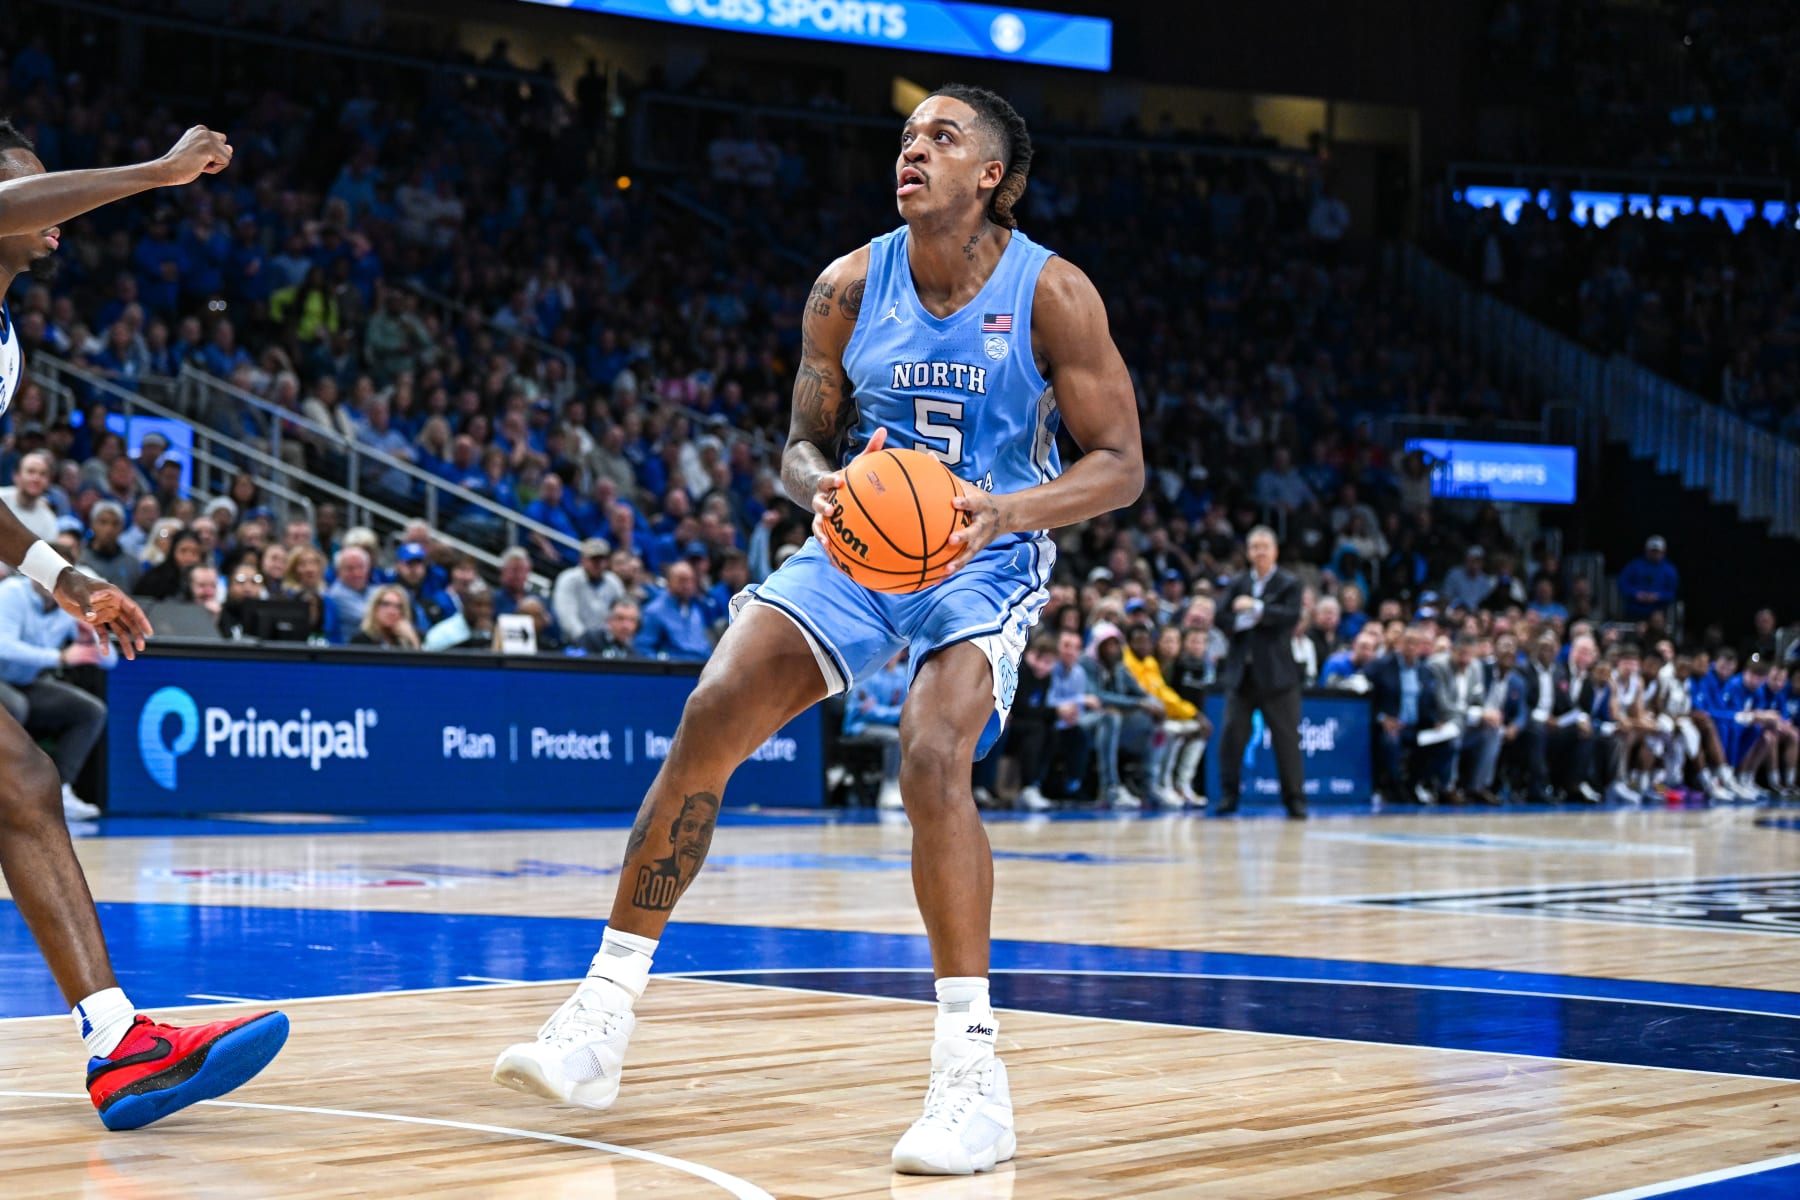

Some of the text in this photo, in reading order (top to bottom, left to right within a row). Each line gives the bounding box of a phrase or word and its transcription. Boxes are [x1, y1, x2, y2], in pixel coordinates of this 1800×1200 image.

[767, 0, 907, 39] SPORTS
[892, 362, 986, 395] NORTH
[913, 396, 965, 467] 5
[442, 725, 496, 759] Plan
[531, 726, 613, 760] Protect
[965, 1022, 994, 1037] ZAMST
